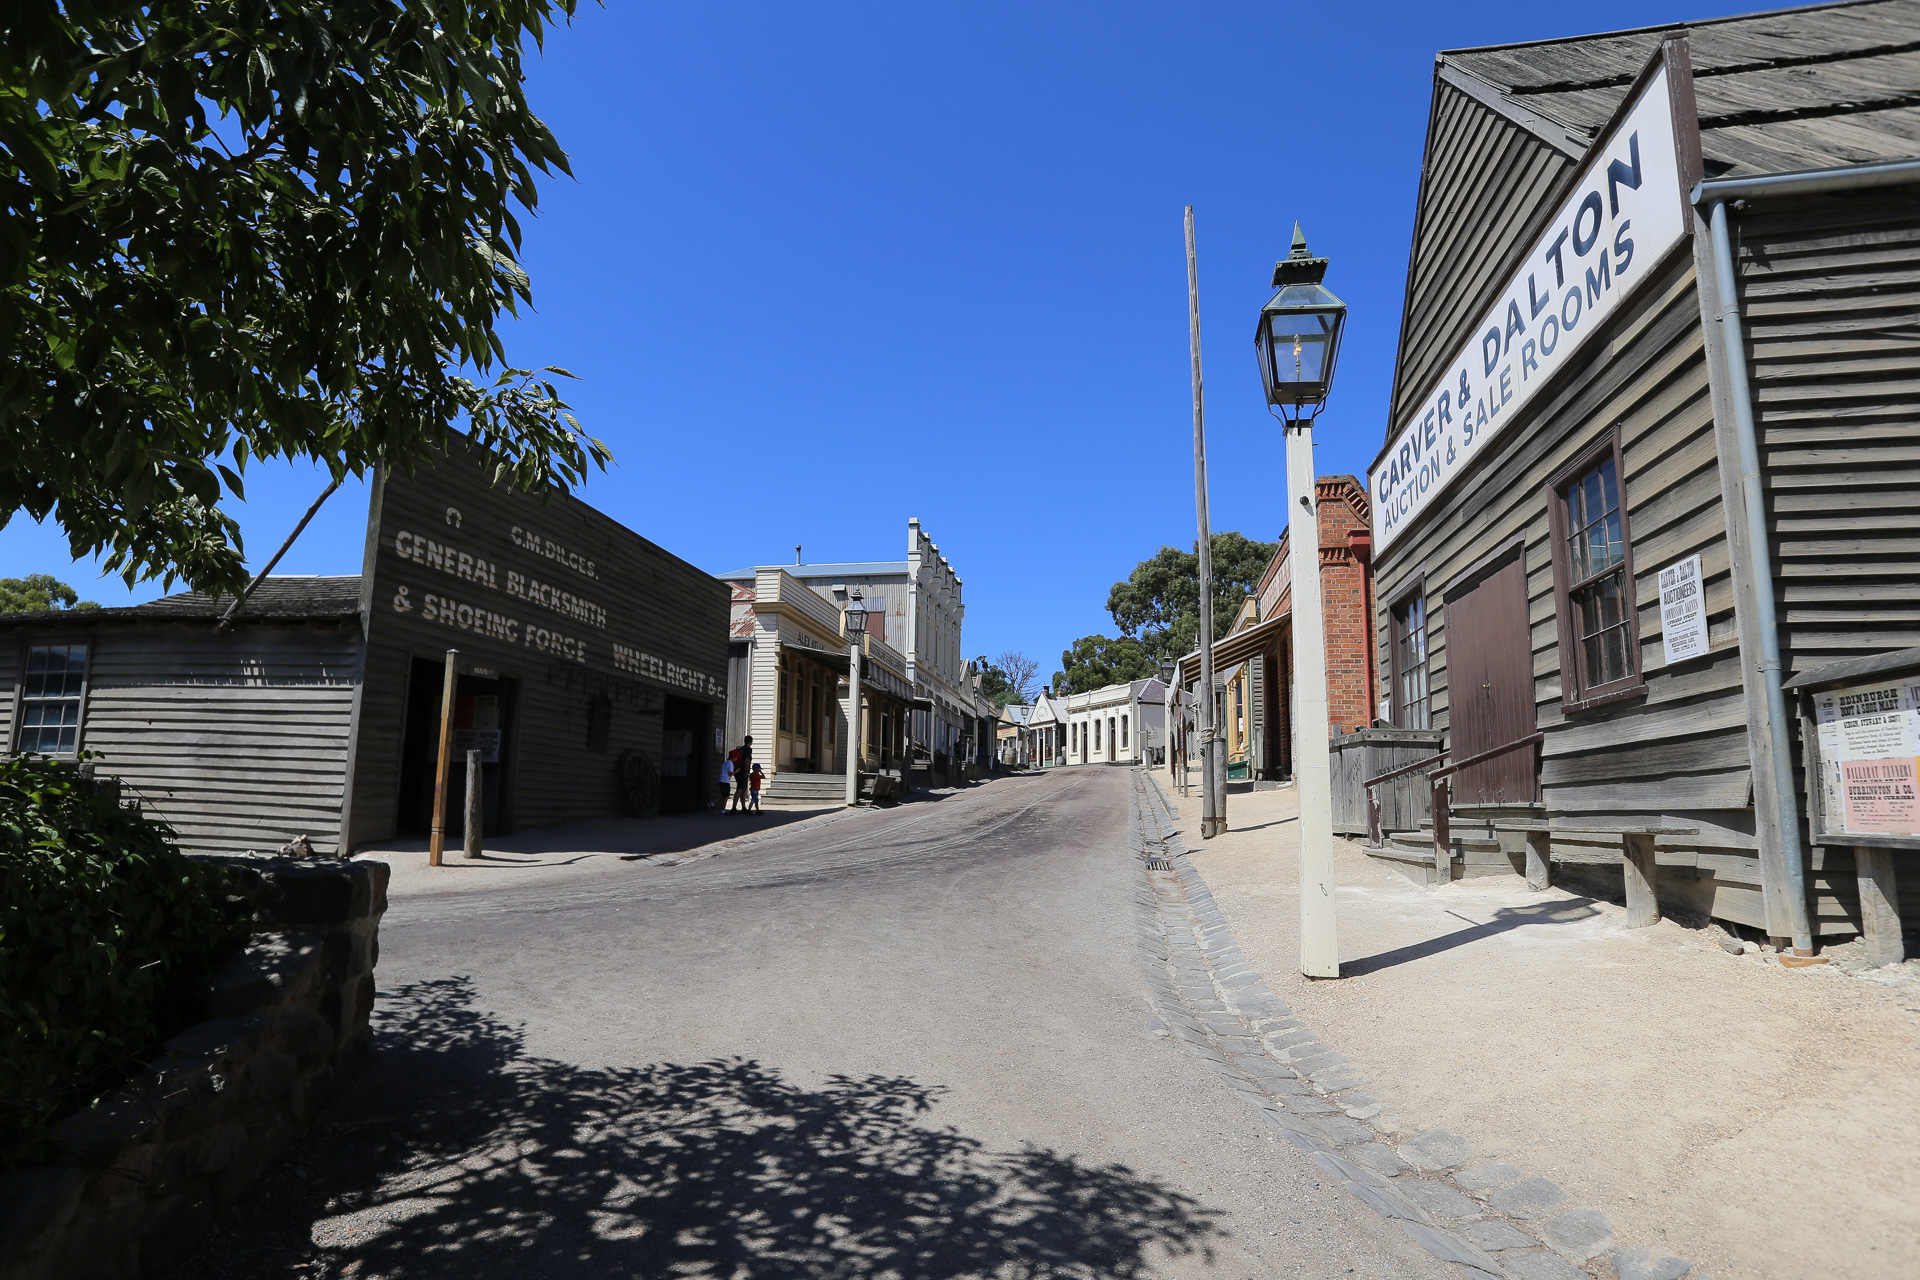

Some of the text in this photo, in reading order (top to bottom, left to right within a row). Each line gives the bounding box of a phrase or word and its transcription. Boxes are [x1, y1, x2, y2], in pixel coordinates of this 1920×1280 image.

[1379, 129, 1643, 503] CARVER & DALTON
[1384, 219, 1635, 535] AUCTION & SALE ROOMS
[395, 530, 607, 629] GENERAL BLACKSMITH
[1663, 580, 1697, 606] AUCTIONEERS
[393, 585, 587, 663] & SHOEING FORGE
[613, 642, 706, 693] WHEELRIGHT
[1839, 688, 1898, 706] EDINBURGH
[1840, 705, 1855, 717] BOOT
[1861, 701, 1878, 714] SHOE
[1878, 699, 1899, 711] MART
[1861, 717, 1882, 726] STEWART
[1846, 764, 1912, 779] BALLARAT TANNERY
[1895, 785, 1900, 794] &
[1902, 784, 1914, 794] CO.
